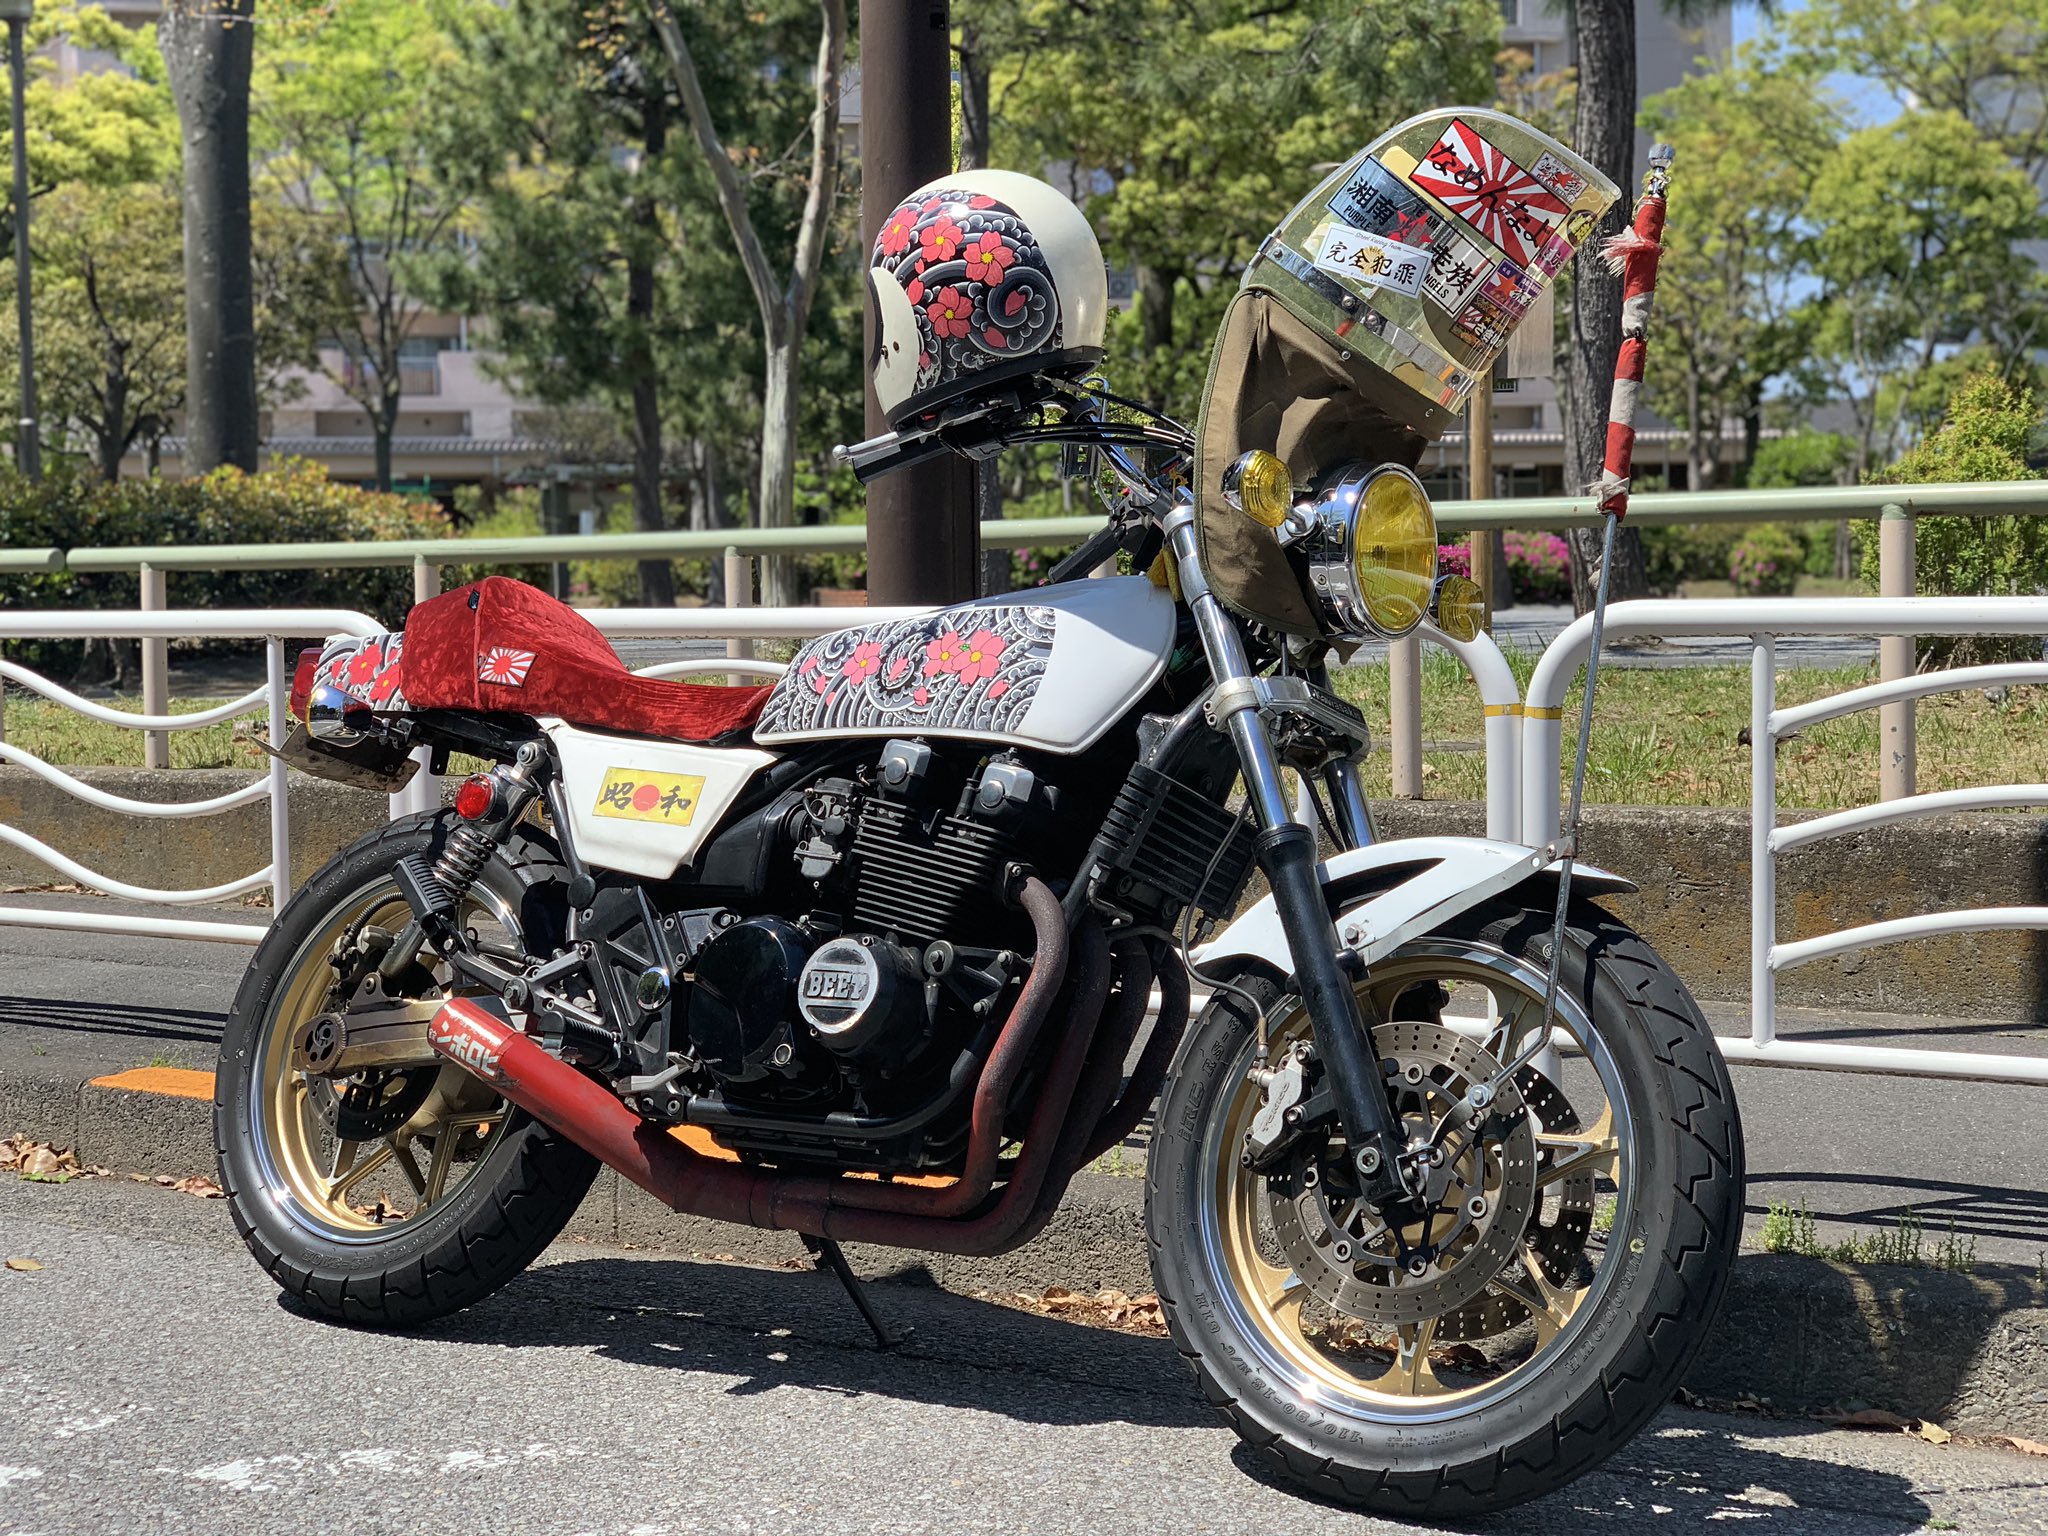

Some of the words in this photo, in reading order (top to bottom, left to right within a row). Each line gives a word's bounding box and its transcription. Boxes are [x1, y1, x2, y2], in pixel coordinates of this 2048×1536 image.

[1346, 176, 1399, 226] 湘南
[1430, 142, 1550, 249] なめんなよ
[1325, 241, 1417, 286] 完全犯罪
[1343, 204, 1373, 232] PURPLE
[1423, 273, 1450, 299] NGELS
[598, 781, 692, 818] 昭和
[806, 970, 868, 1001] BEET
[1250, 1377, 1364, 1444] 110/90-18
